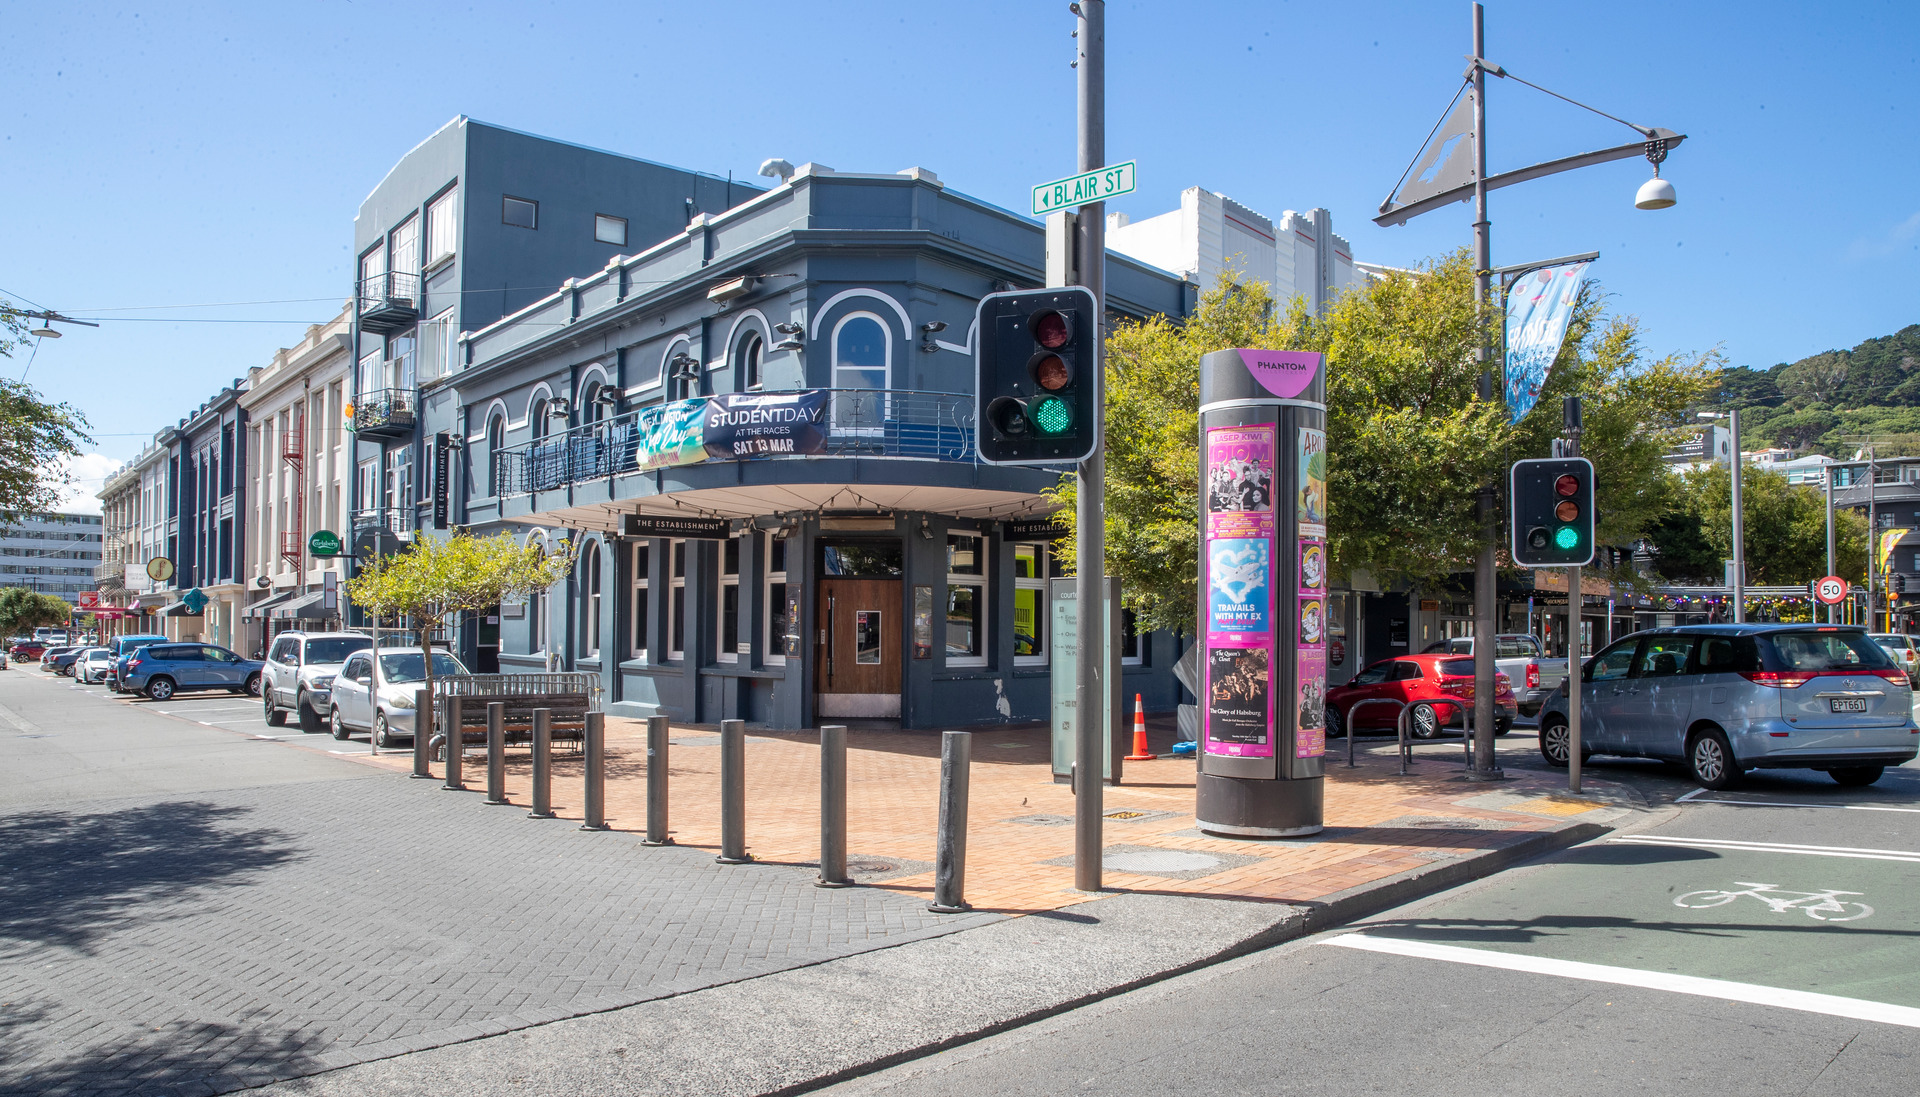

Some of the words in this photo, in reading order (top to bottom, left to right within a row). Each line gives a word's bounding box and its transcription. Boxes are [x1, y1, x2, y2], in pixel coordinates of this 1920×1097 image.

[1054, 176, 1097, 206] BLAIR
[1105, 169, 1123, 193] ST
[1257, 361, 1307, 371] PHANTOM
[710, 407, 821, 428] STUDENTDAY
[735, 428, 745, 437] AT
[746, 427, 762, 436] THE
[763, 426, 791, 435] RACES
[1214, 434, 1240, 442] LASER
[1242, 433, 1263, 441] KIWI
[733, 440, 753, 455] SAT
[756, 439, 768, 452] 13
[769, 438, 795, 452] MAR
[1303, 432, 1322, 456] ARO
[637, 519, 652, 528] THE
[655, 521, 720, 531] ESTABLISHMENT
[1013, 525, 1026, 533] THE
[312, 538, 339, 549] Carlsberg
[864, 556, 873, 564] 16
[1822, 585, 1840, 596] 50
[1217, 603, 1256, 612] TRAVAILS
[1214, 612, 1234, 621] WITH
[1235, 612, 1249, 620] MY
[1250, 612, 1262, 620] EX
[1833, 700, 1864, 710] EPT661
[1217, 708, 1230, 716] Glory
[1236, 709, 1261, 717] Habsburg
